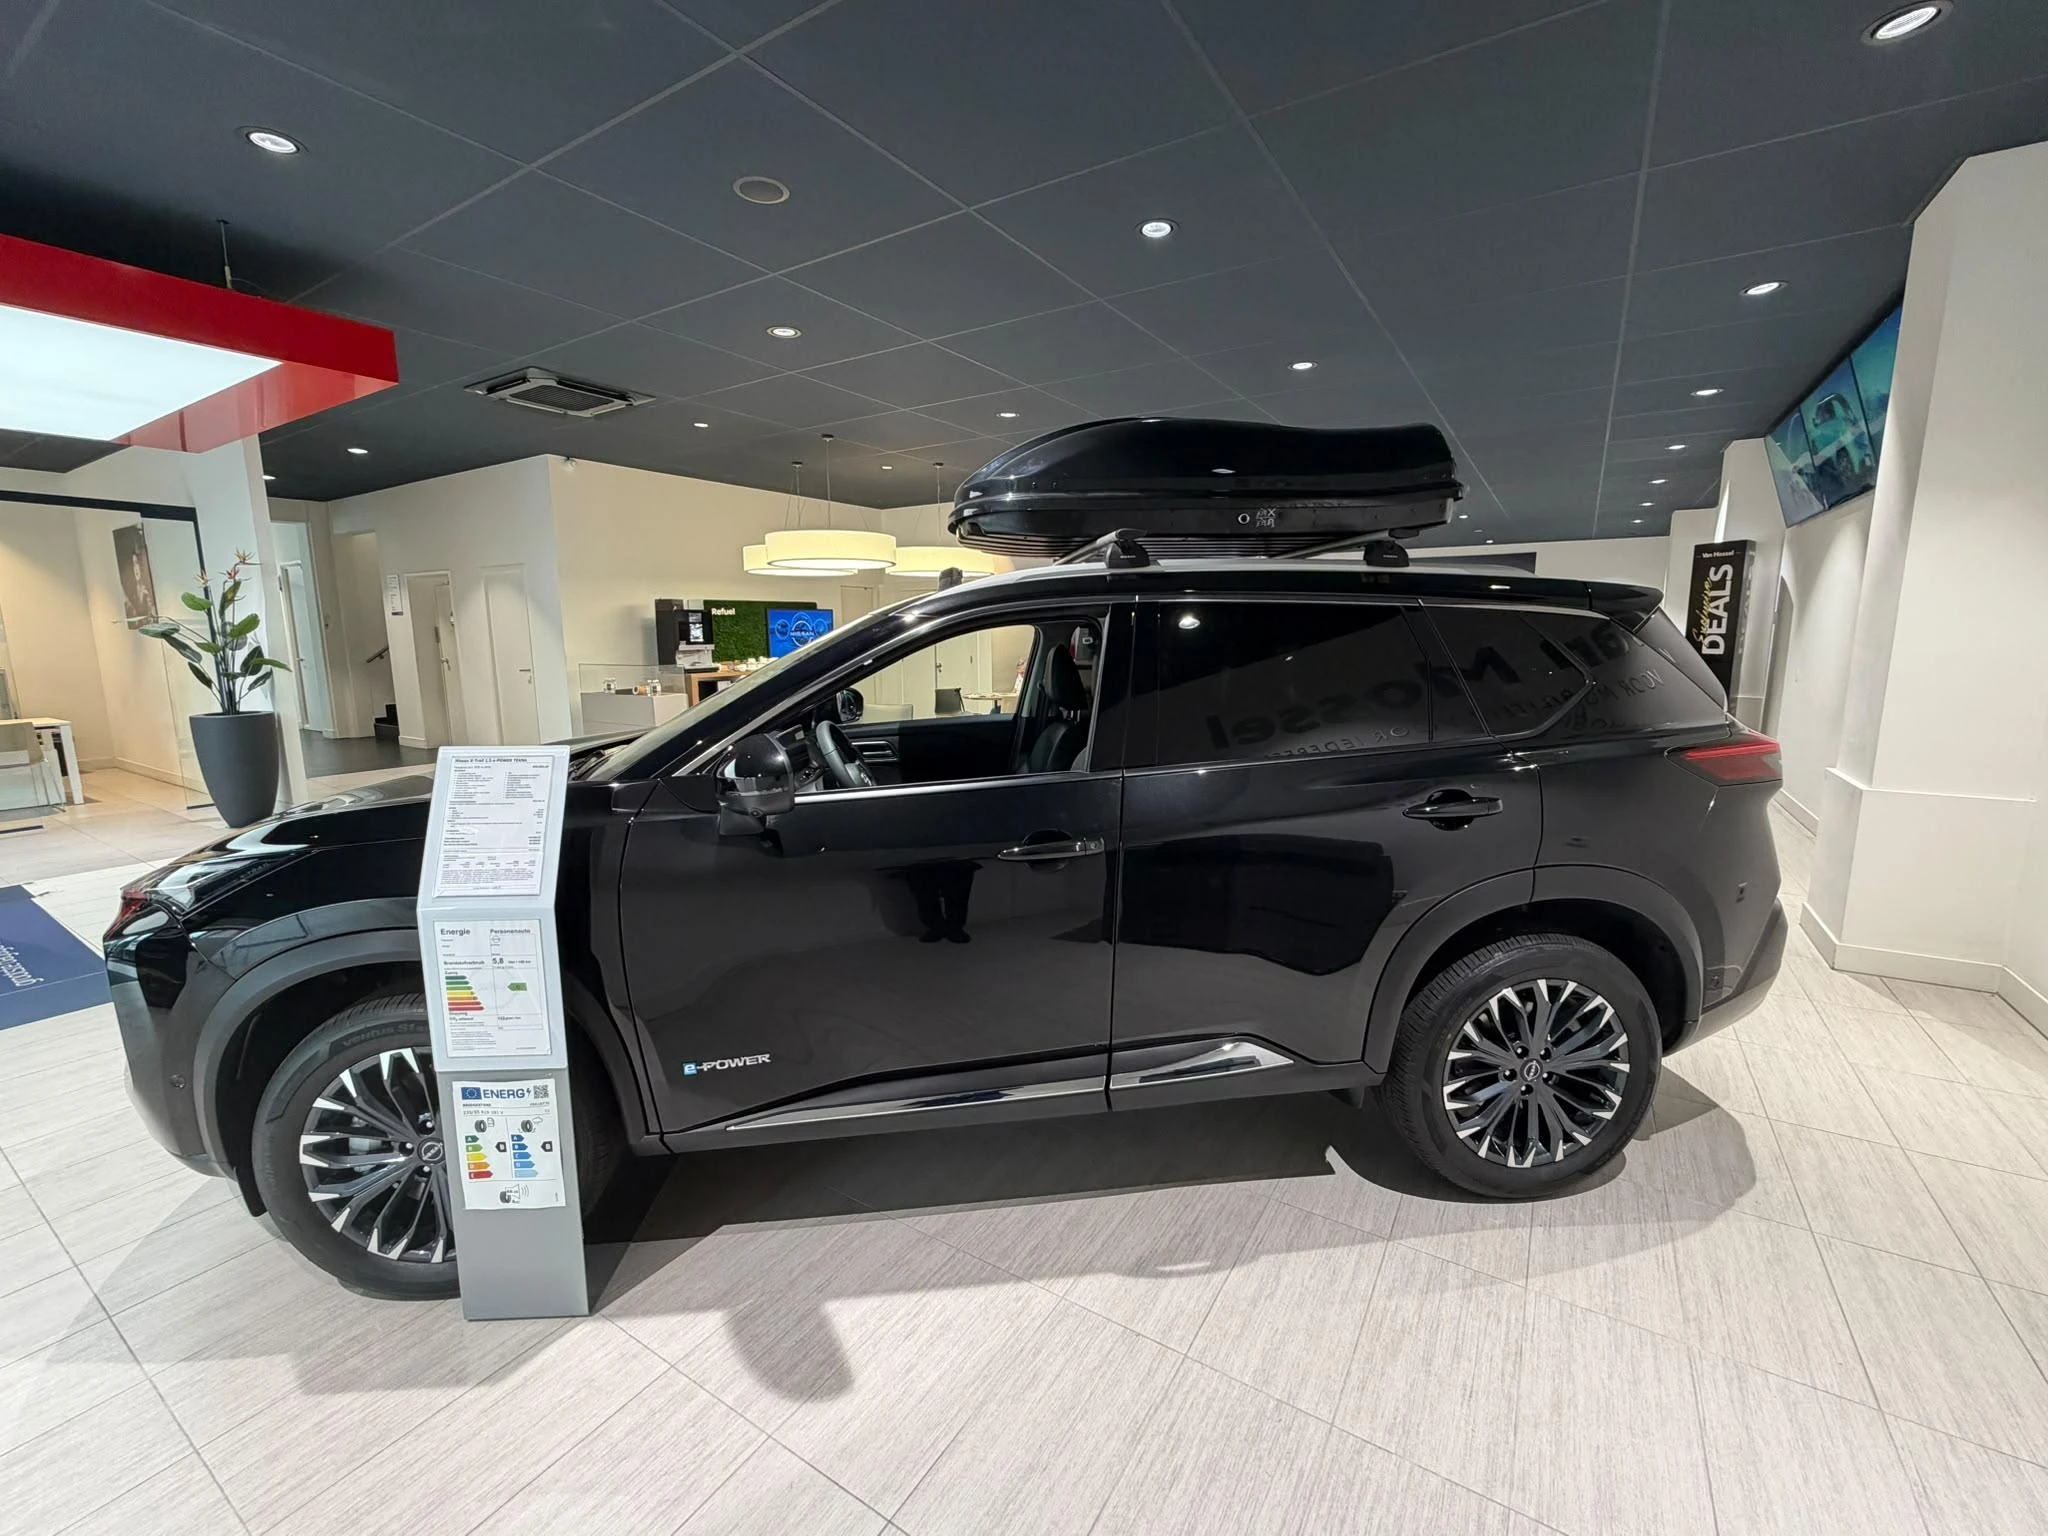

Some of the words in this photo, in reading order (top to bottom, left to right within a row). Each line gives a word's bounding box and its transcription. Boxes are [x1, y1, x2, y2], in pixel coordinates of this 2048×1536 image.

[711, 607, 736, 616] Refuel
[1701, 564, 1734, 655] DEALS
[440, 928, 471, 937] Energie
[683, 1053, 771, 1076] e-POWER
[482, 1088, 526, 1100] ENERG
